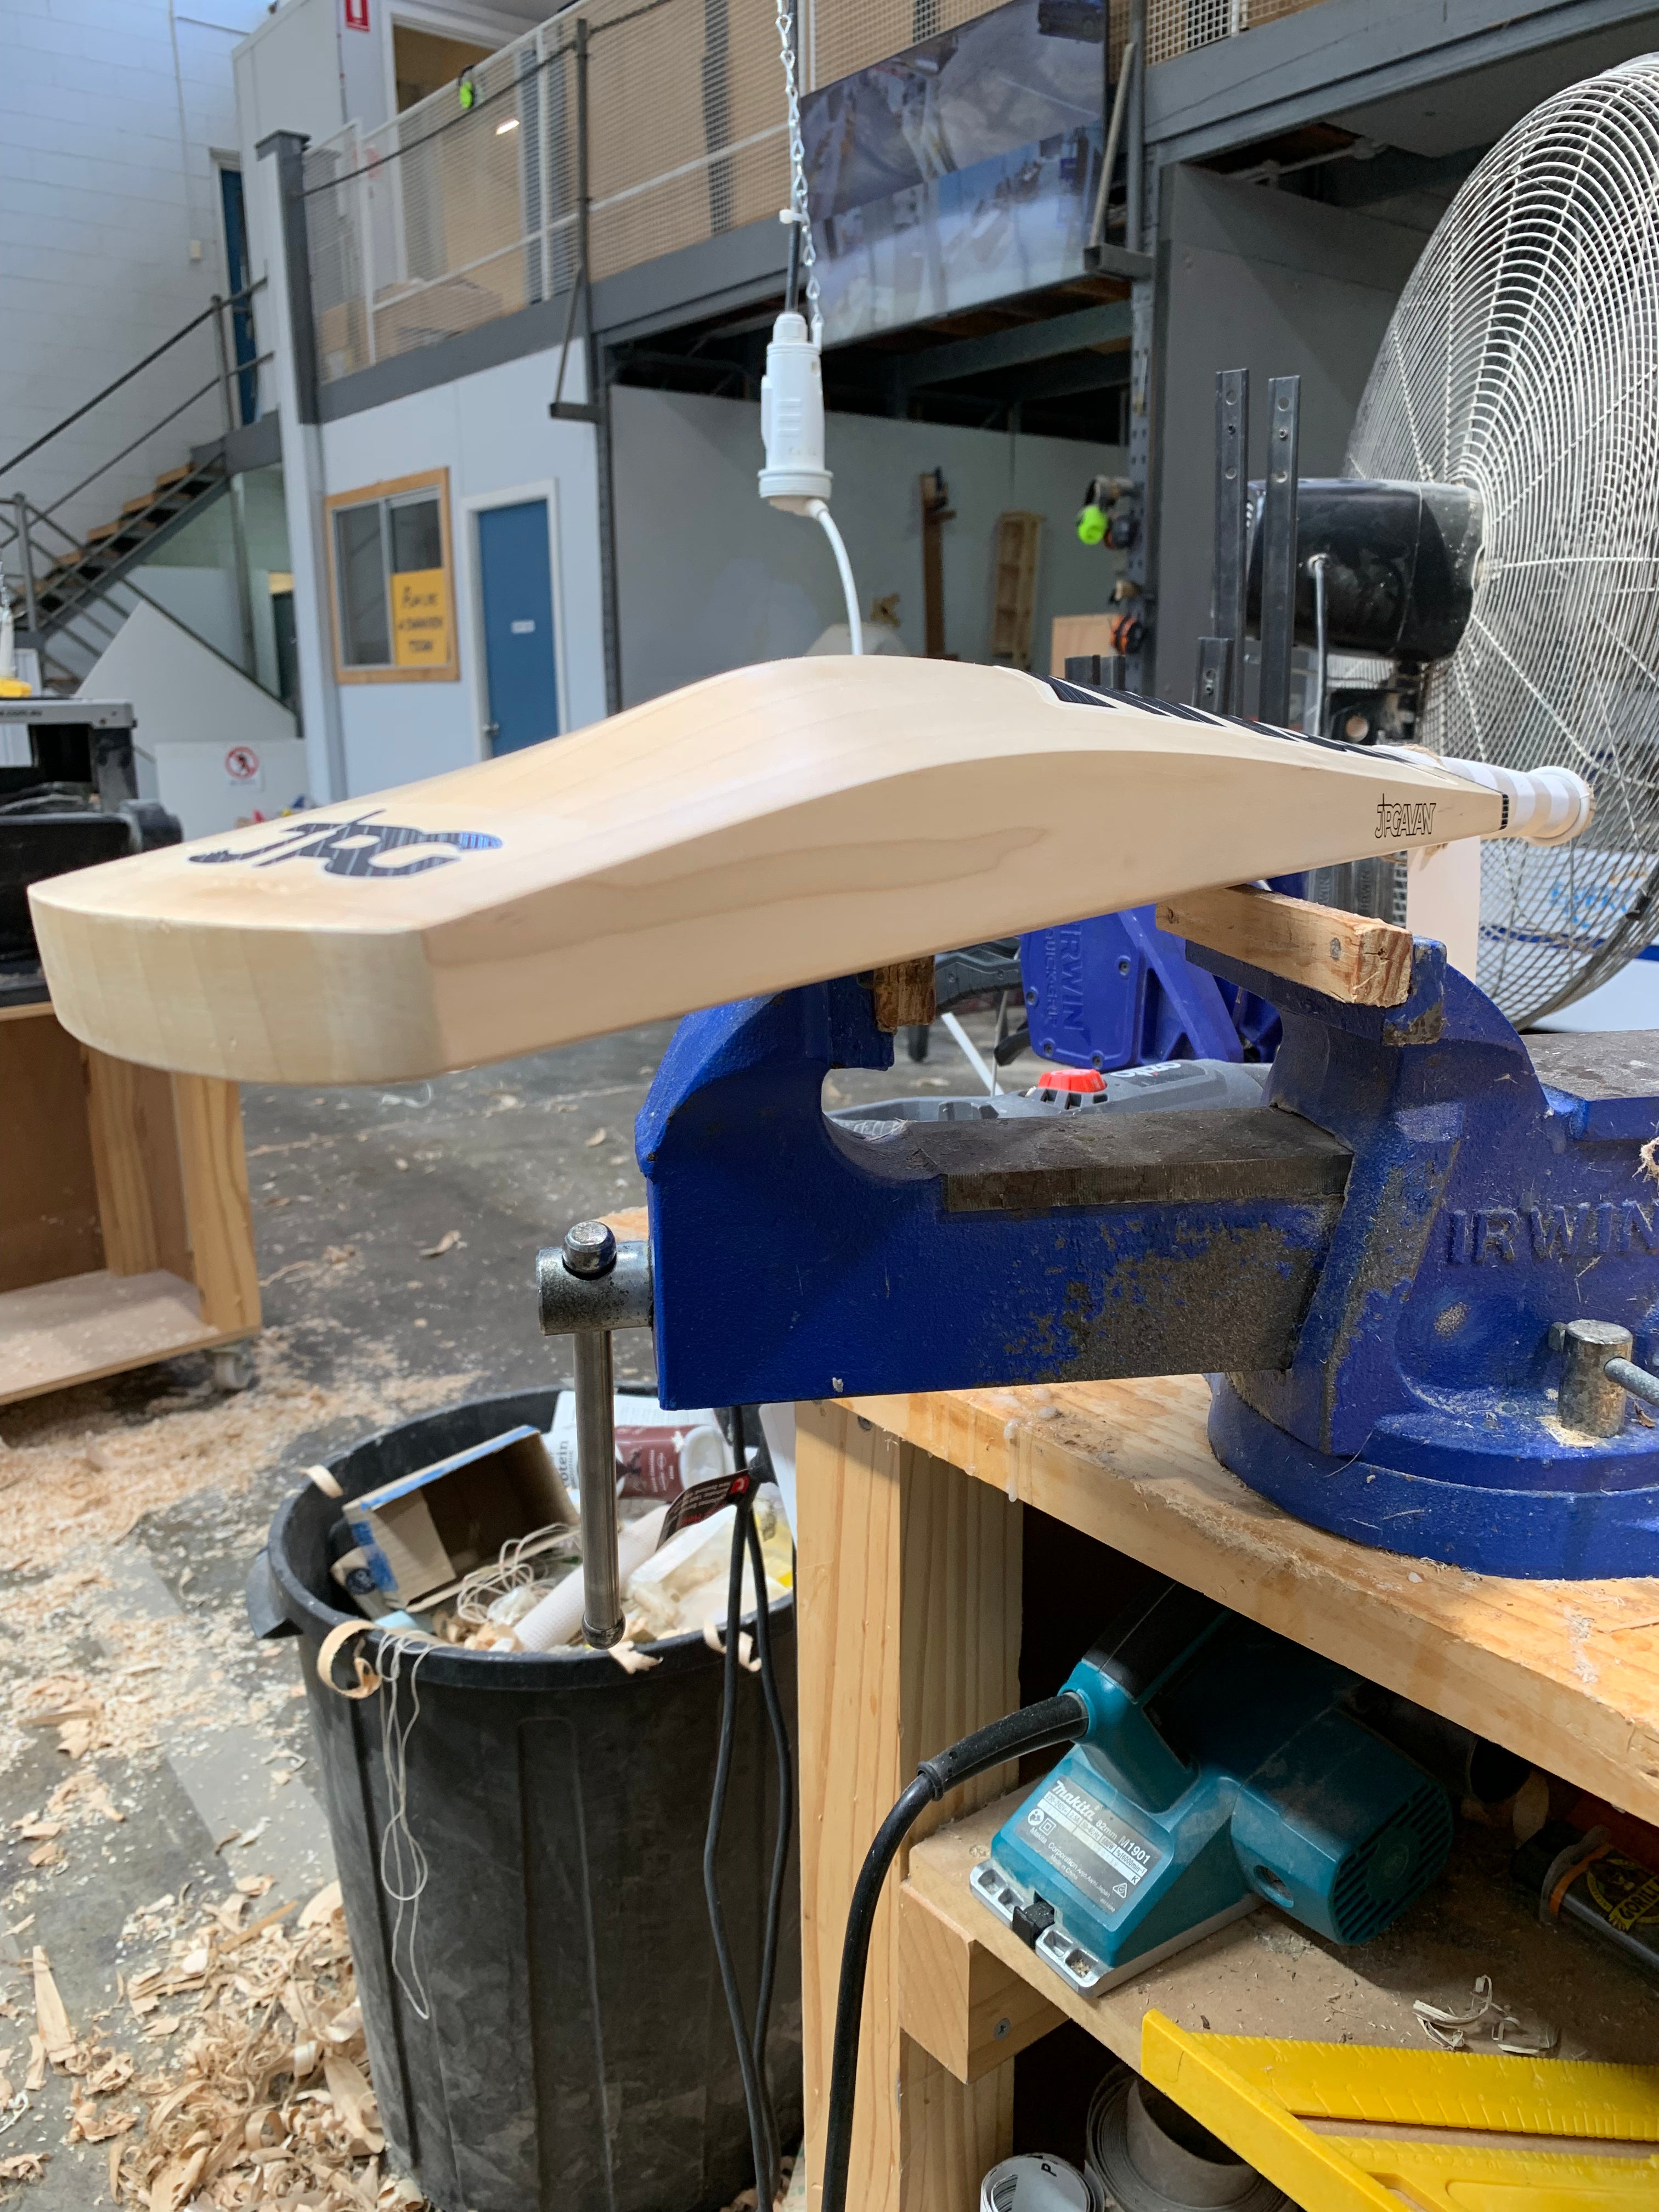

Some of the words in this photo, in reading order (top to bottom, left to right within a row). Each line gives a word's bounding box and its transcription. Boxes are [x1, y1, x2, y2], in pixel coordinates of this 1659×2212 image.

[1060, 923, 1084, 1031] IRWIN
[1446, 1199, 1659, 1265] IRWIN
[1030, 1827, 1047, 1844] Makita
[1048, 1842, 1078, 1870] Corporation
[1096, 1819, 1118, 1840] 82mm
[1118, 1835, 1150, 1864] M1901
[1131, 1876, 1139, 1885] K
